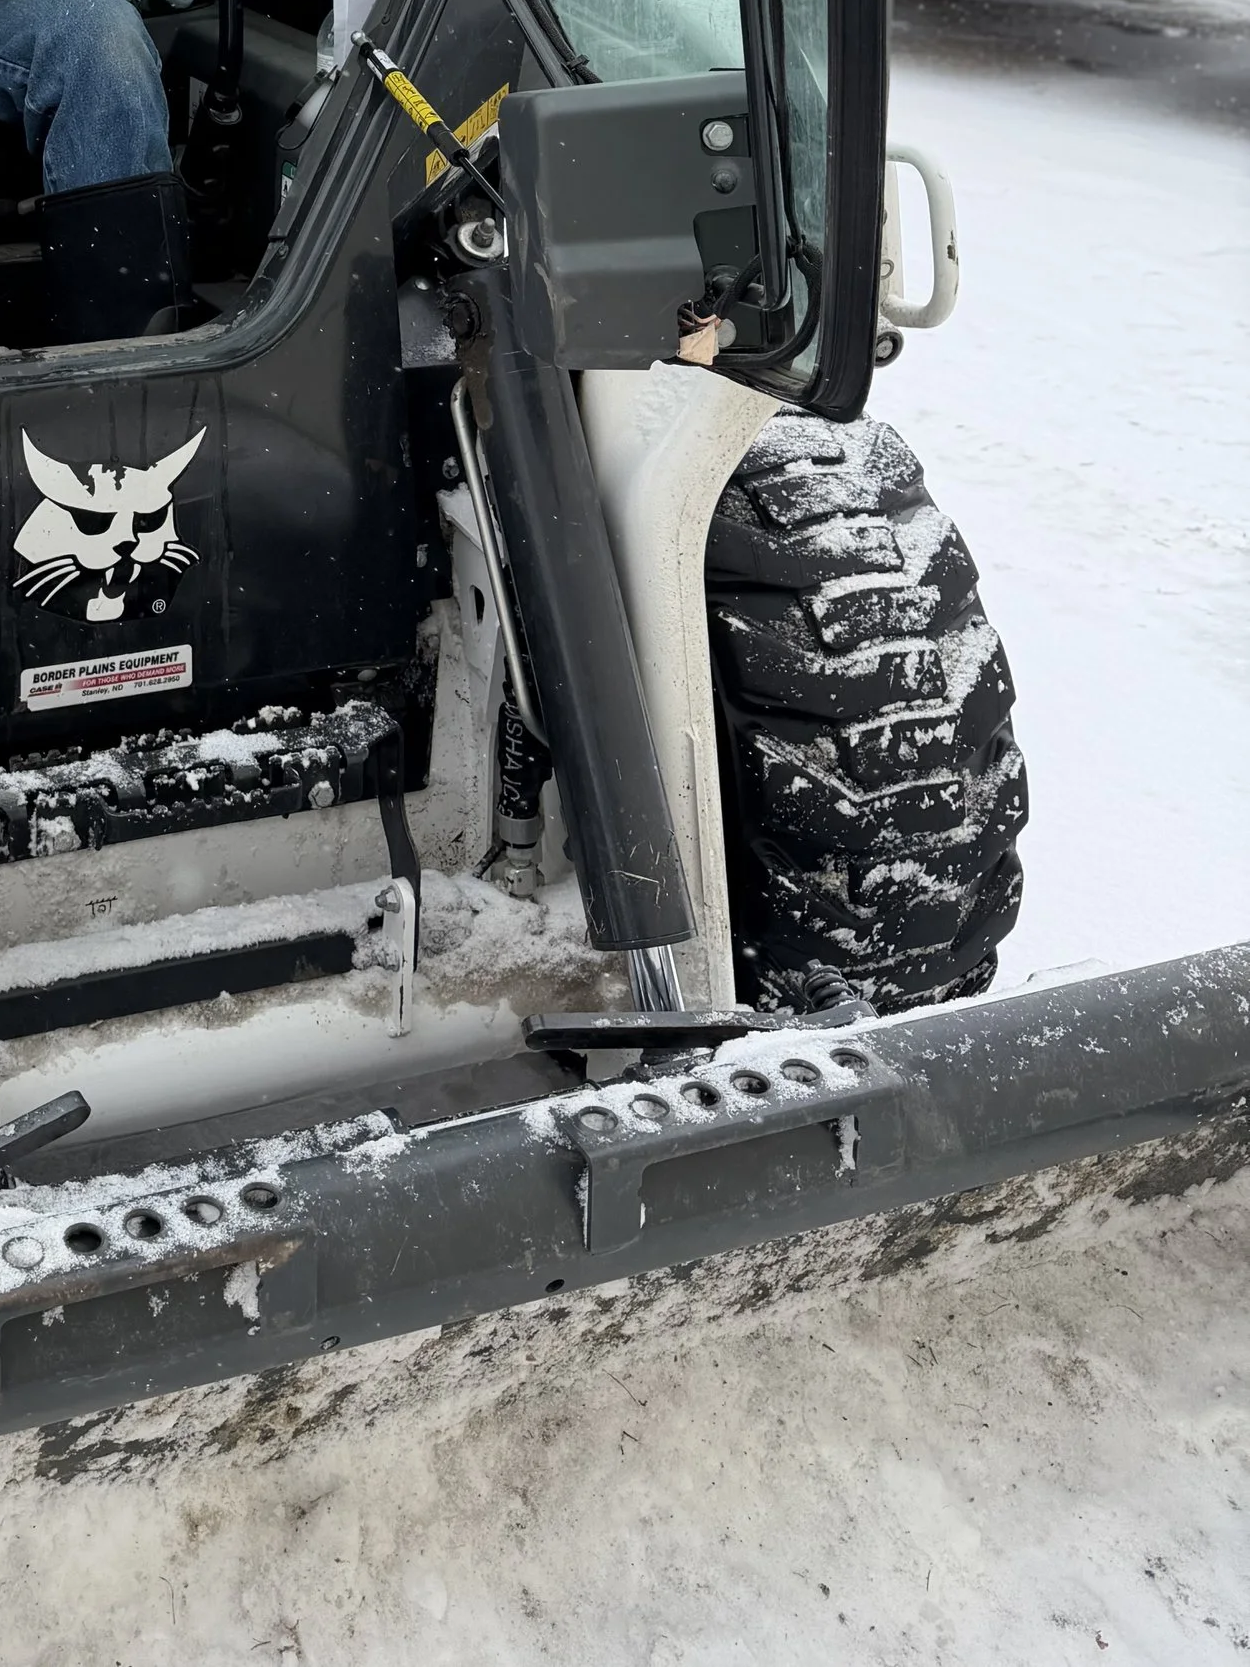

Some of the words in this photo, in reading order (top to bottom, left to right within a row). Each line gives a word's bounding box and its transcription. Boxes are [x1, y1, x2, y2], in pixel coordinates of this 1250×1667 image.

[33, 668, 76, 684] BORDER
[78, 661, 116, 678] PLAINS
[119, 651, 180, 670] EQUIPMENT
[82, 678, 98, 687] FOR
[98, 675, 120, 685] THOSE
[120, 672, 136, 681] WHO
[137, 668, 165, 680] DEMAND
[165, 664, 185, 674] MORE
[29, 685, 54, 694] CASE
[112, 684, 124, 692] ND
